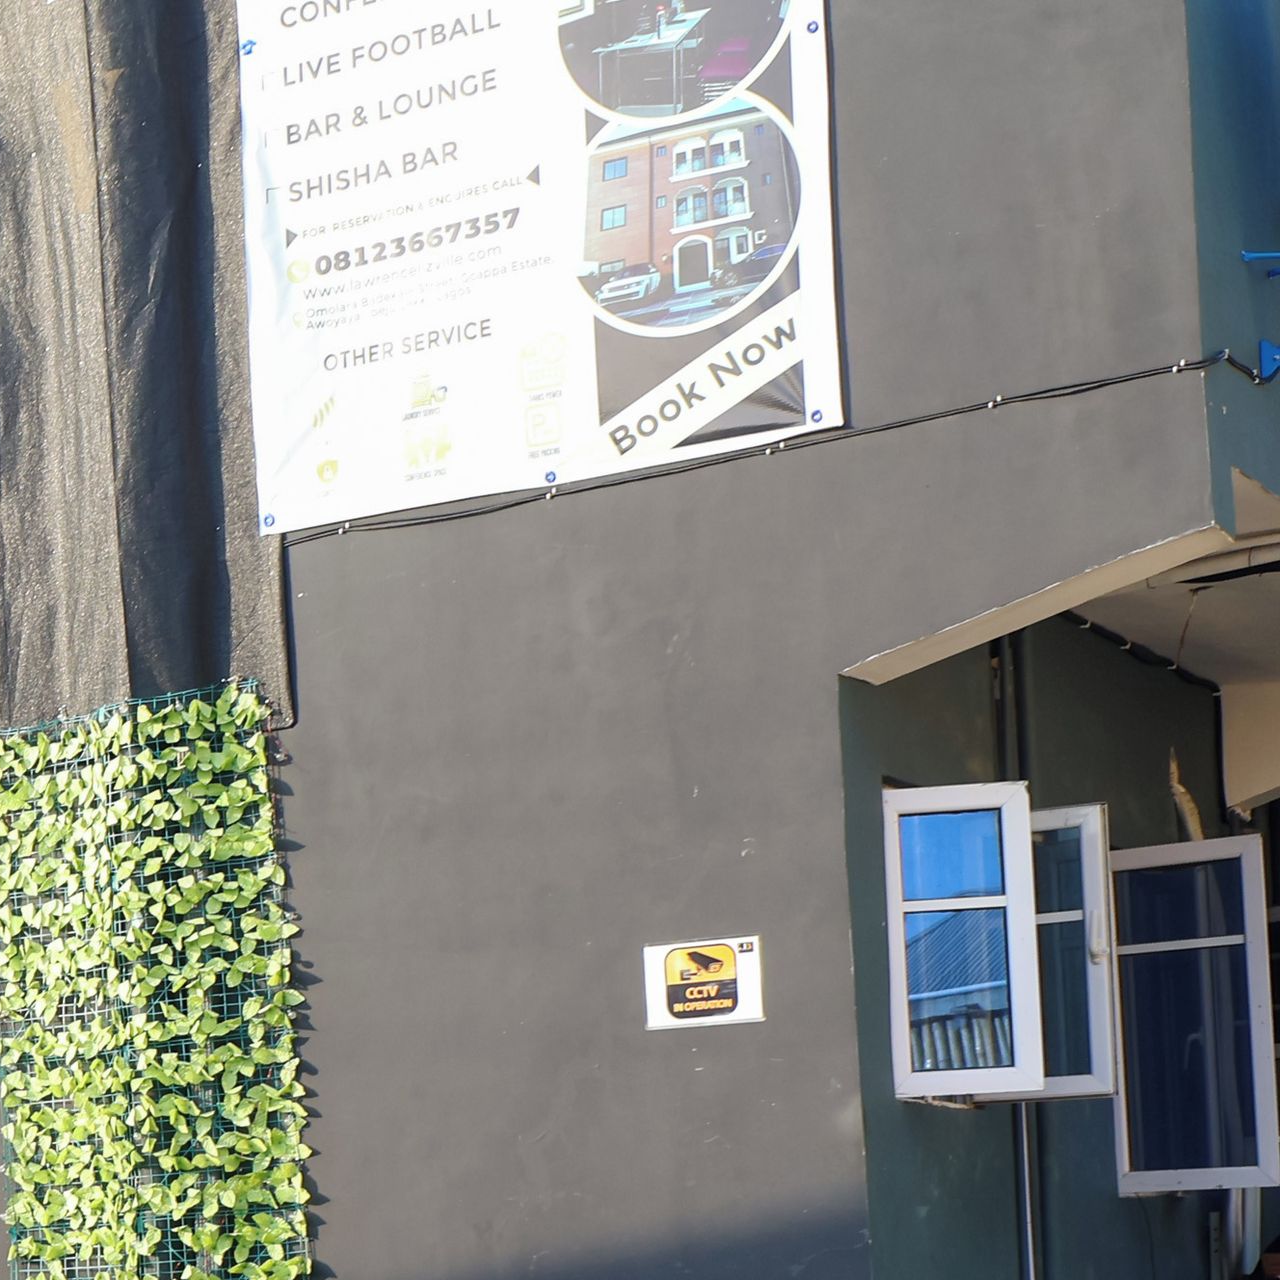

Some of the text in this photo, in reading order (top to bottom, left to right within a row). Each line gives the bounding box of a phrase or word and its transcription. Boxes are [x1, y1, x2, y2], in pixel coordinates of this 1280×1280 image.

[280, 0, 377, 27] CON
[282, 9, 501, 87] LIVE FOOTBALL
[286, 69, 497, 145] BAR & LOUNGE
[288, 141, 458, 202] SHISHA BAR
[302, 225, 326, 239] FOR
[332, 204, 414, 232] RESERVION
[492, 176, 523, 191] CALL
[314, 207, 521, 276] 08123667357
[322, 318, 492, 372] OTHER SERVICE
[608, 318, 797, 456] Book Now
[684, 998, 733, 1012] OPERATION
[685, 985, 719, 999] CCTV
